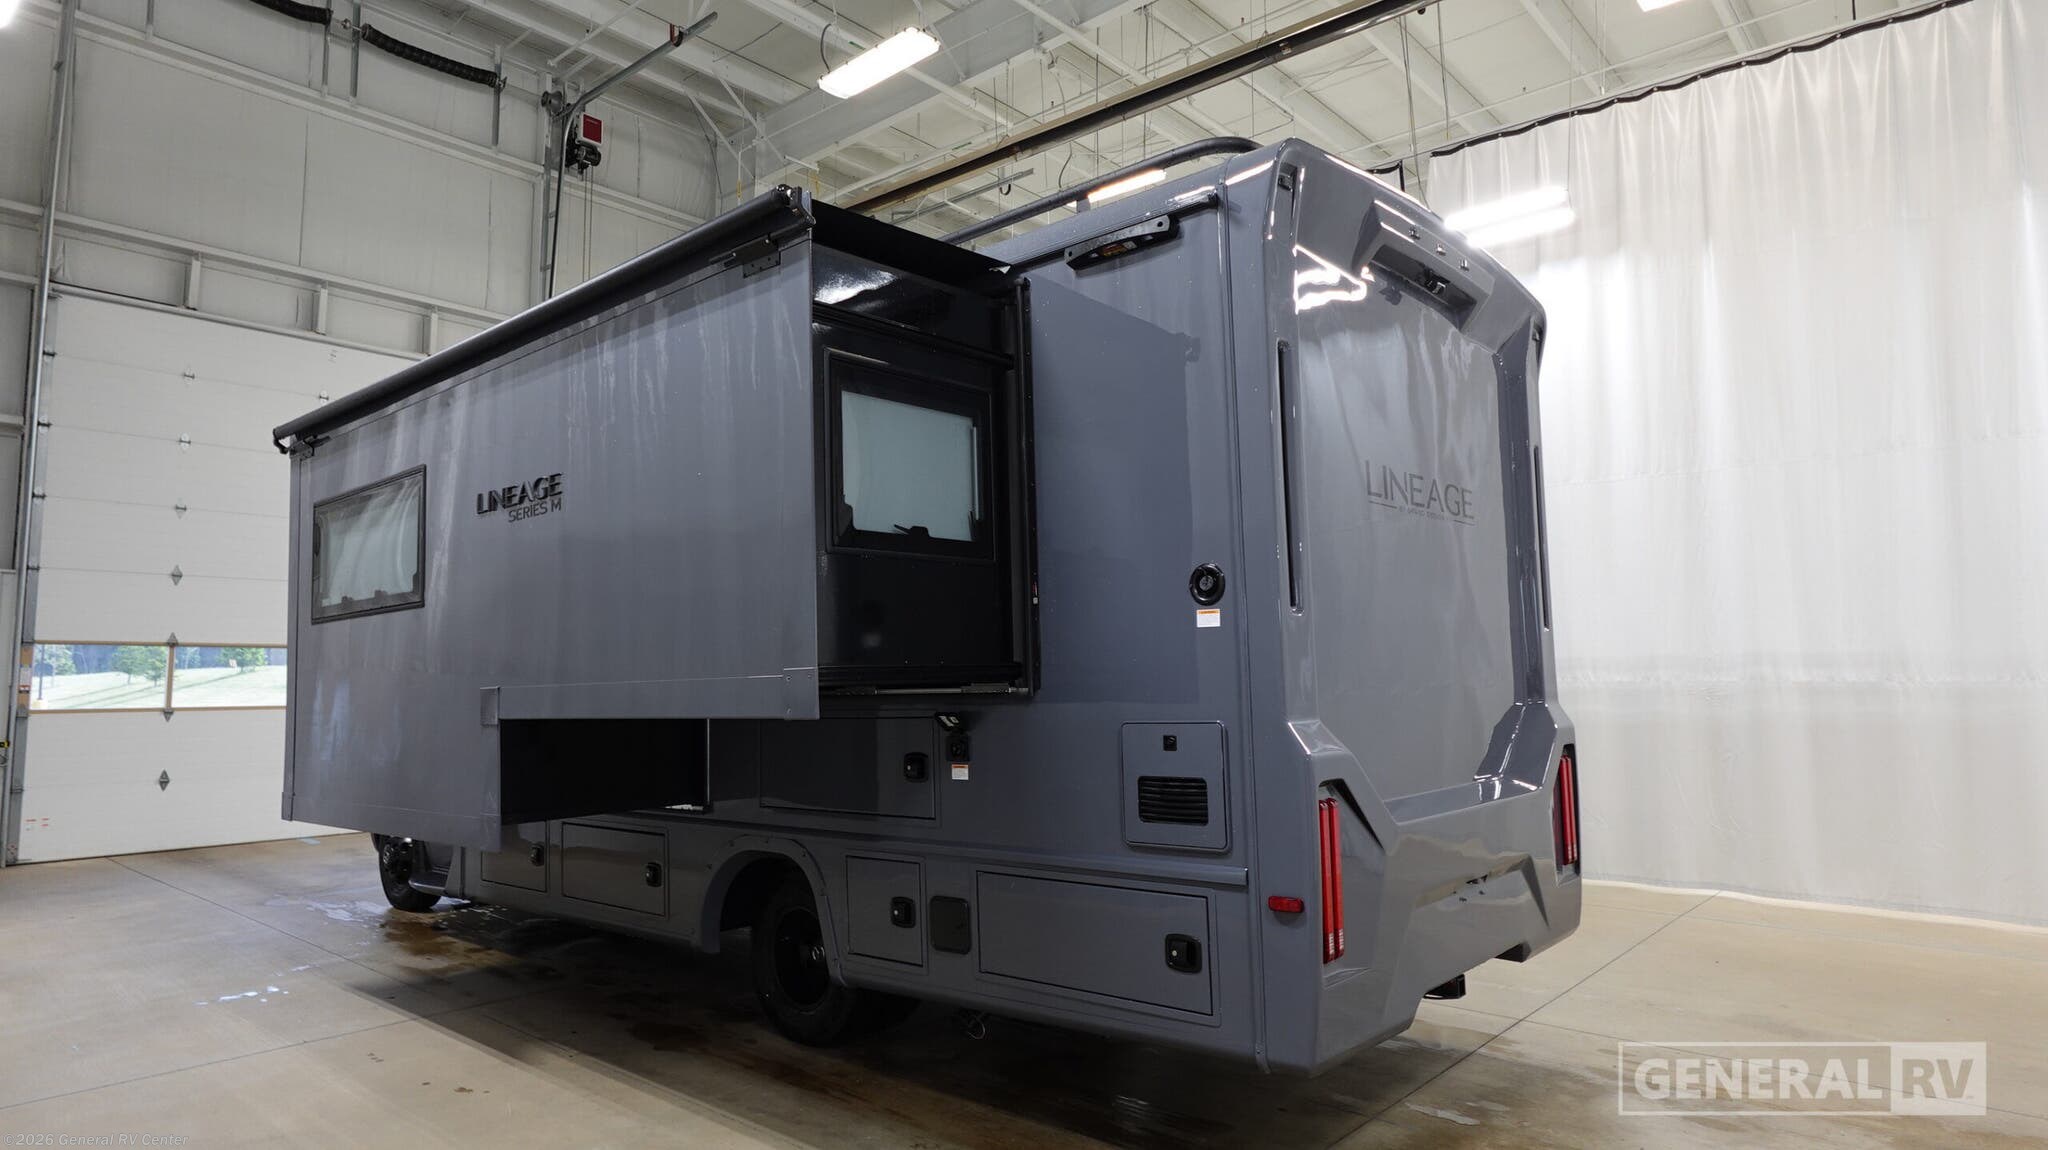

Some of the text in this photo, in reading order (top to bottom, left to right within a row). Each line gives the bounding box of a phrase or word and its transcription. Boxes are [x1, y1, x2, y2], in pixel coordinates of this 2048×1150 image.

[476, 472, 563, 515] LINEAGE
[508, 498, 562, 523] SERIES M
[1365, 460, 1475, 520] LINEAGE
